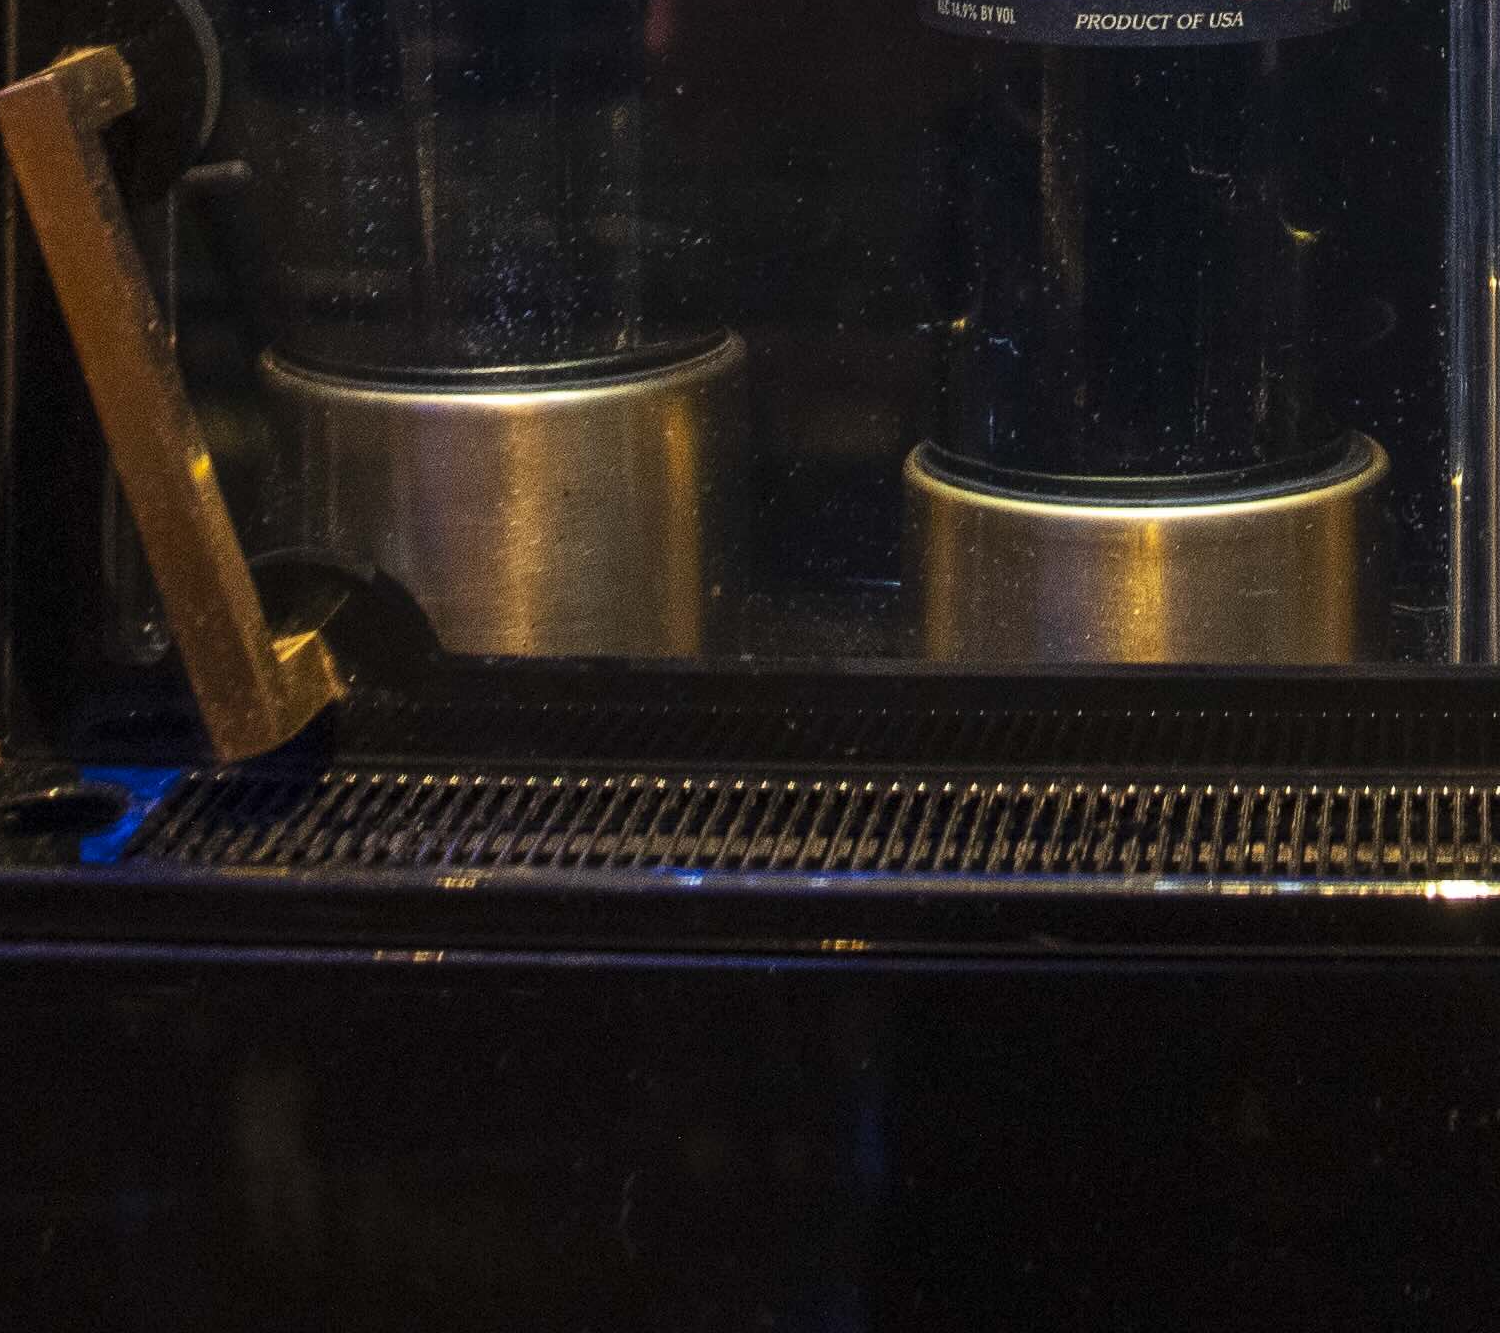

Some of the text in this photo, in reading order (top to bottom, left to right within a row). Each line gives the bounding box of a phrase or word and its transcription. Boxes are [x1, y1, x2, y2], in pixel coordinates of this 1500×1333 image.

[980, 4, 994, 22] BY
[996, 6, 1017, 24] VOL
[1074, 10, 1245, 31] PRODUCT OF USA
